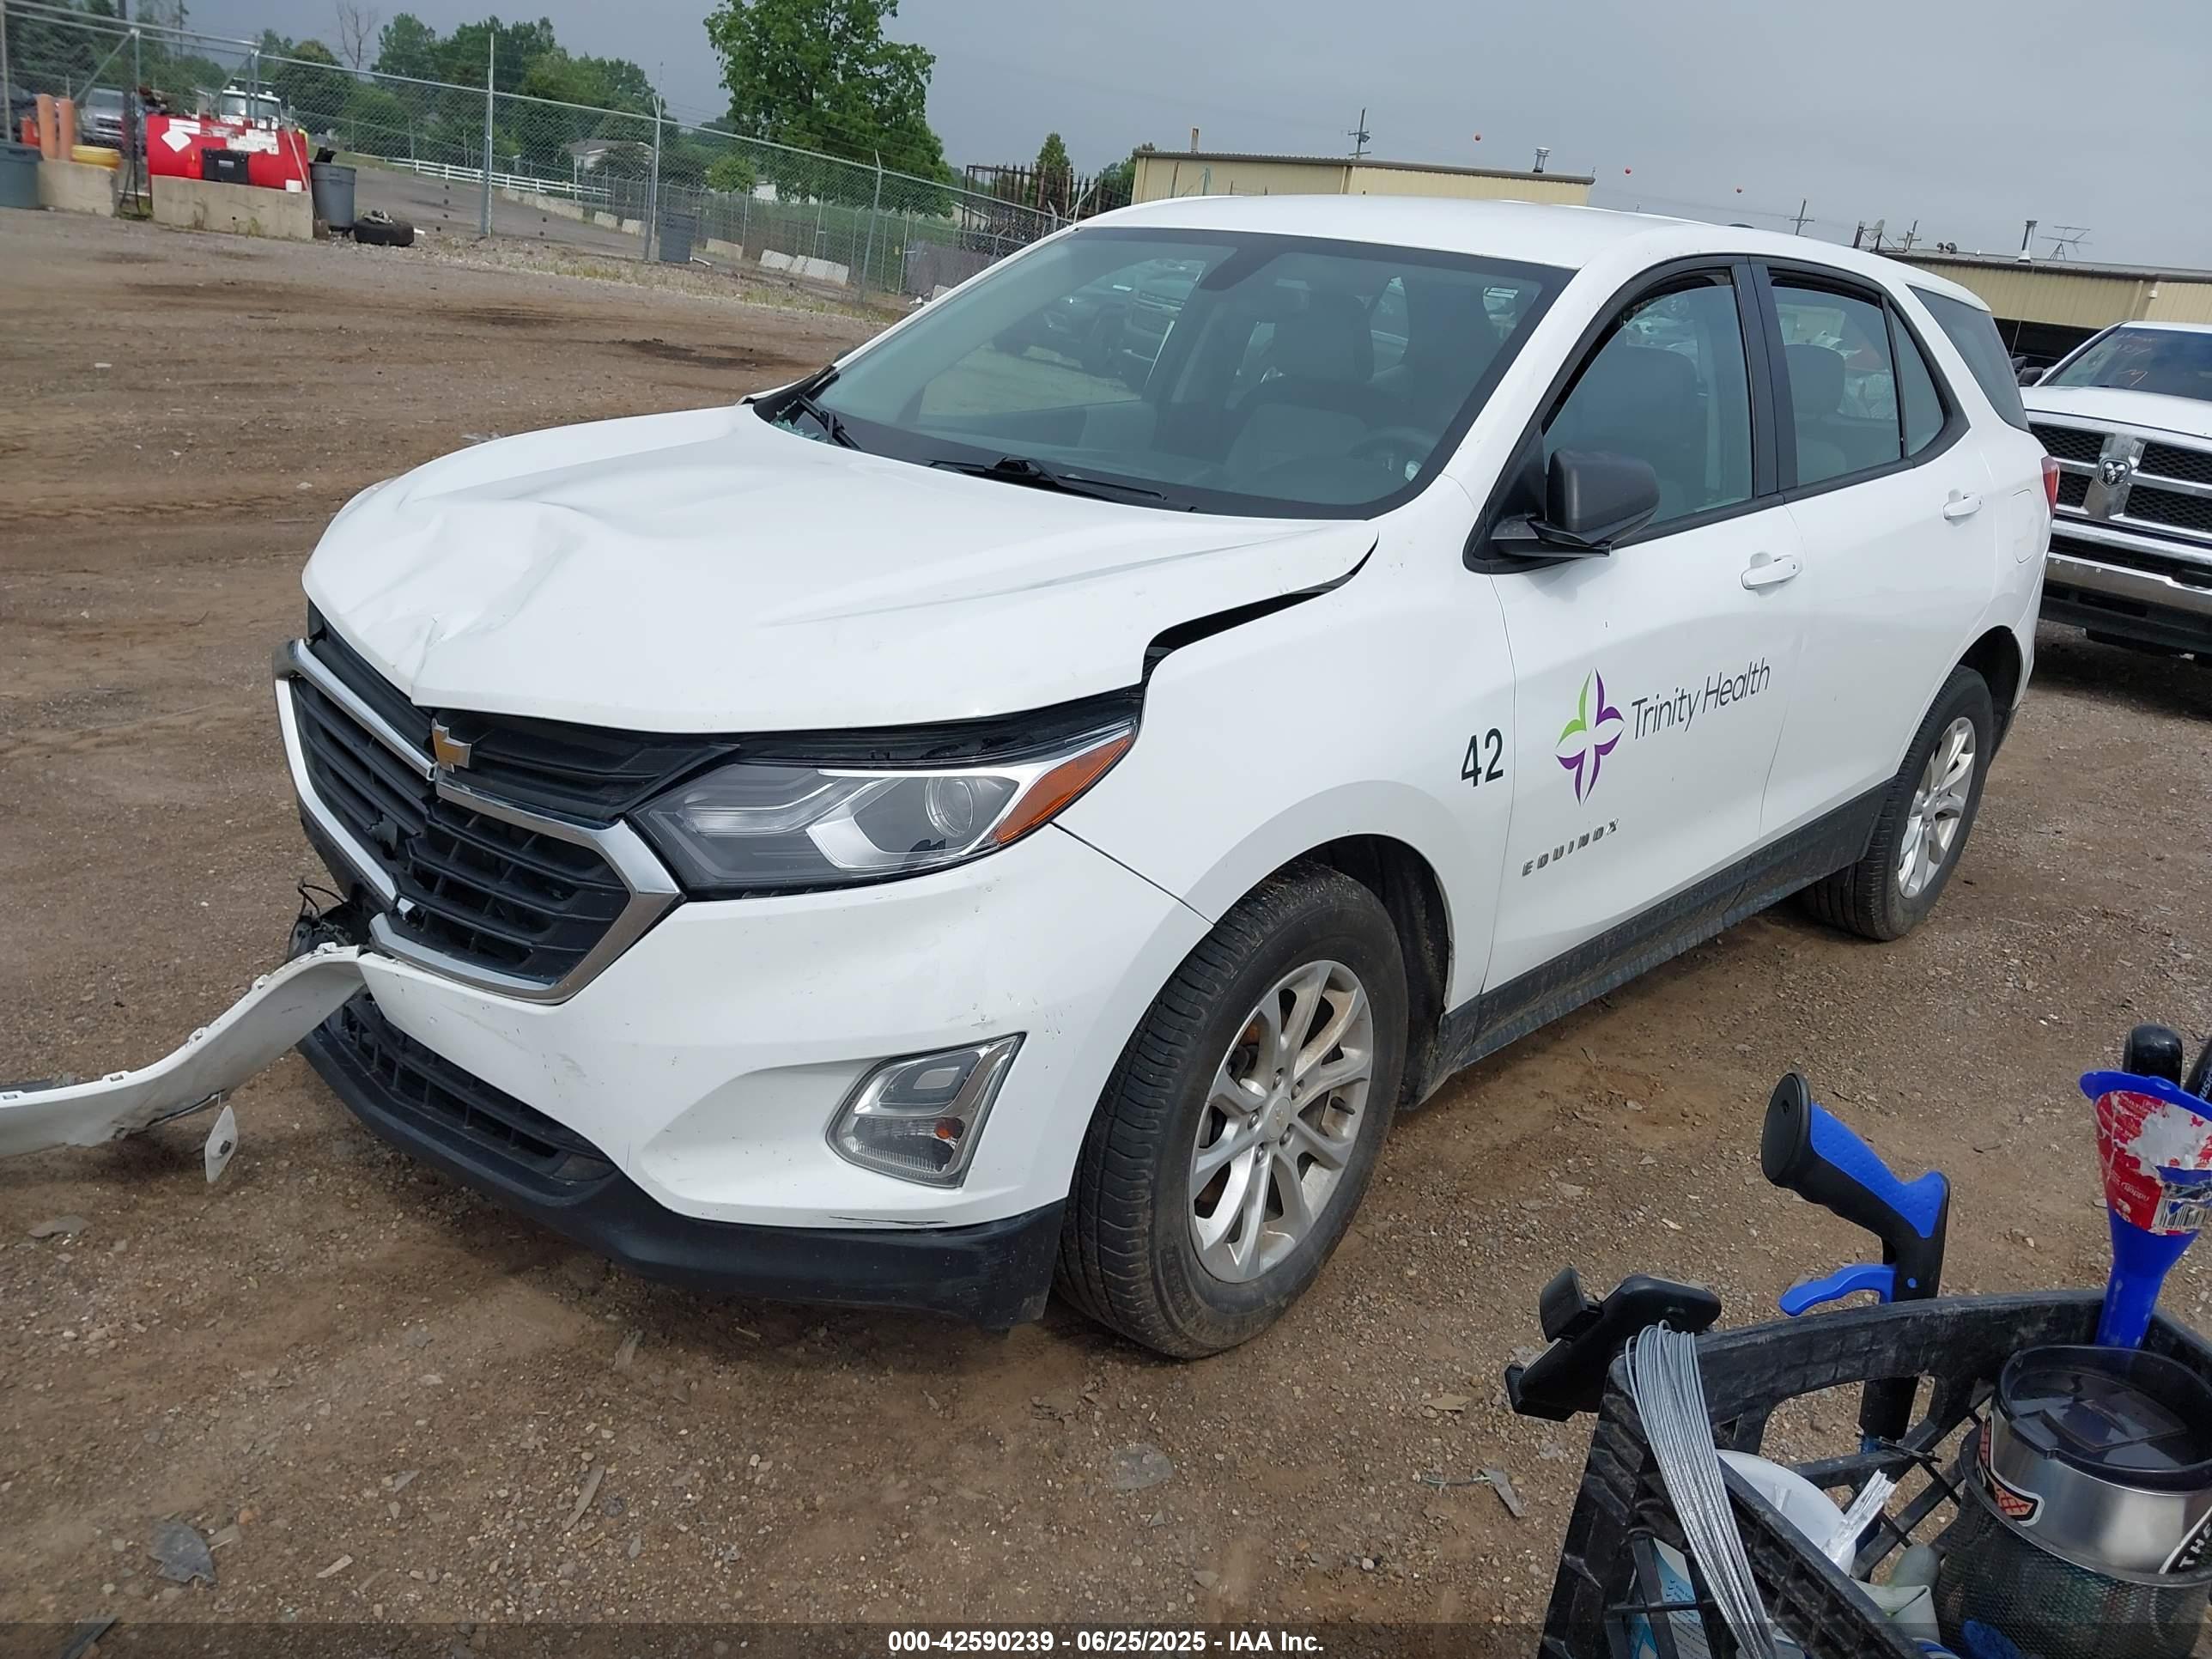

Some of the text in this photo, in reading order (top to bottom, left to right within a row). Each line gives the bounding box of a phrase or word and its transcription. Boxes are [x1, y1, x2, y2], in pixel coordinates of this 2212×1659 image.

[1631, 657, 1771, 739] Trinity Health
[1461, 727, 1504, 787] 42
[1522, 817, 1620, 877] EQUINOX
[2179, 1522, 2212, 1568] THE
